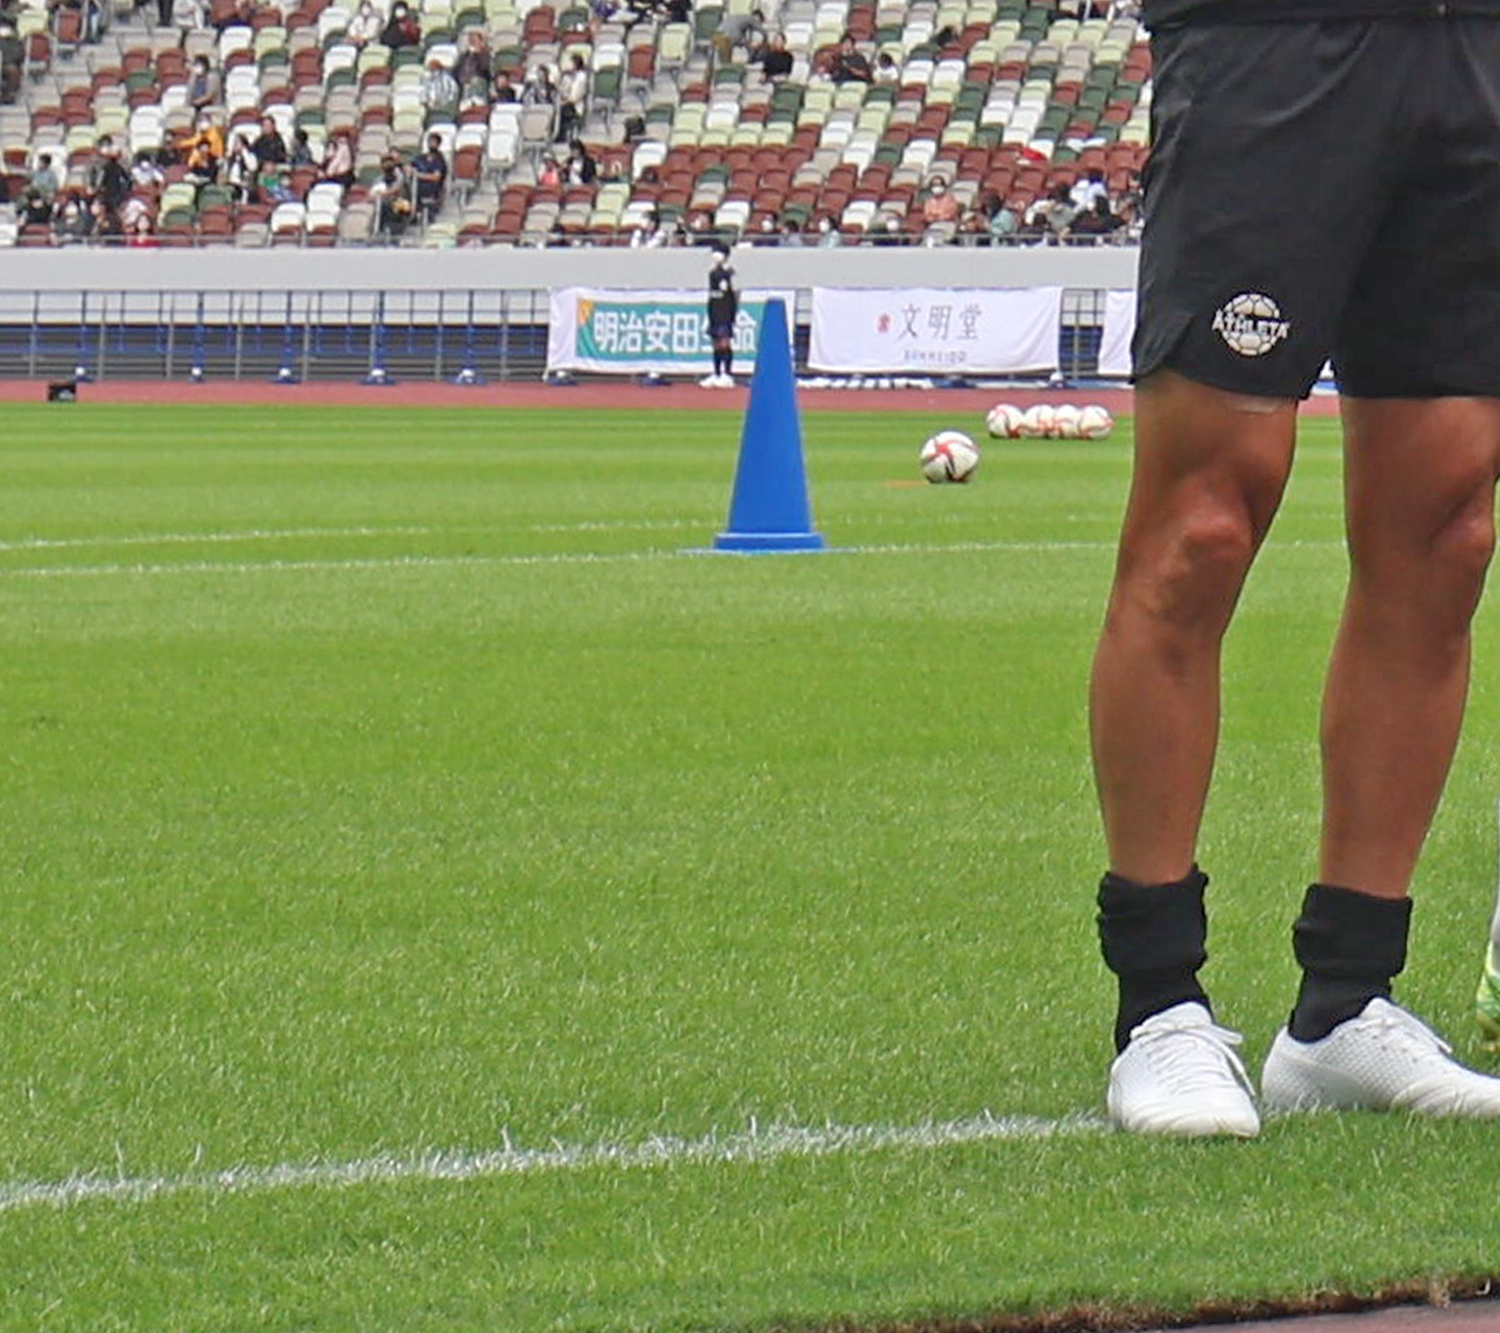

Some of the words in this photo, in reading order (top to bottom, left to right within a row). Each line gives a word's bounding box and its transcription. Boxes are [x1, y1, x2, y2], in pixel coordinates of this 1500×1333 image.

[900, 302, 981, 342] 文明堂
[1211, 308, 1290, 339] ATHLETA
